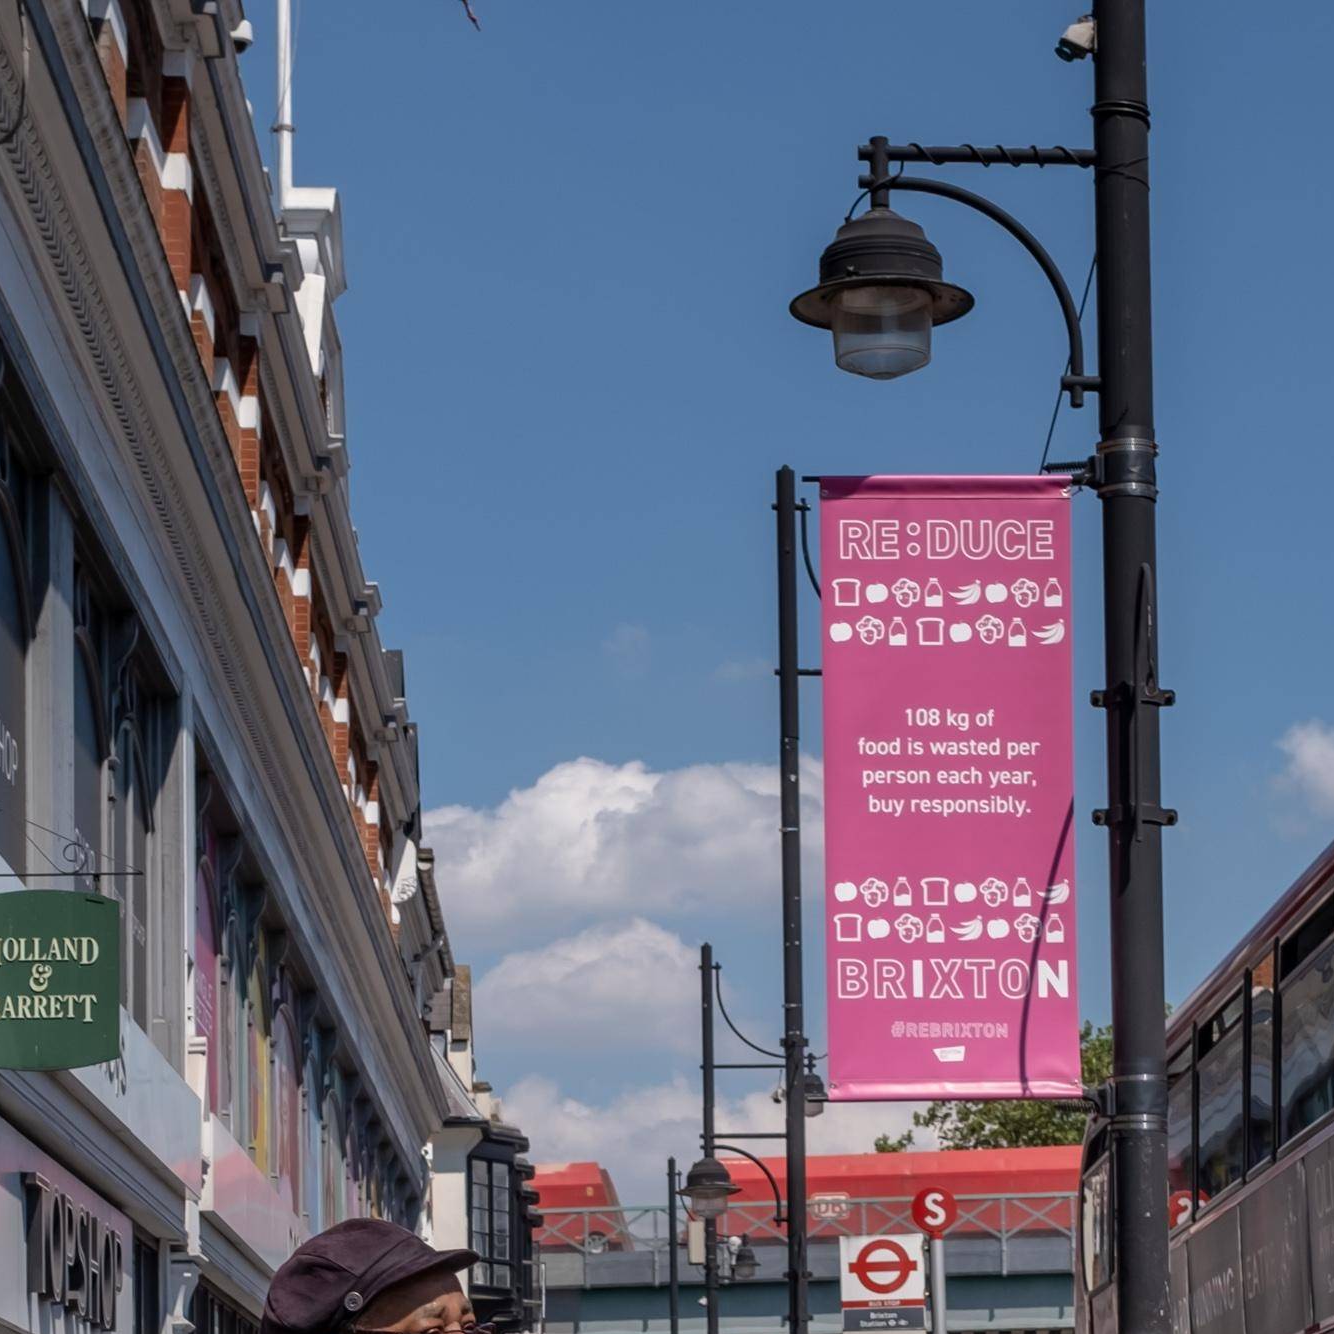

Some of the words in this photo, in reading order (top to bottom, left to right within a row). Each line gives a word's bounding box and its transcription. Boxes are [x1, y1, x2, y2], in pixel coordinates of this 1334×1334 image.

[839, 519, 1055, 561] RE:DUCE
[905, 708, 941, 727] 108
[946, 708, 970, 732] kg
[975, 708, 995, 727] of
[857, 737, 901, 756] food
[907, 737, 924, 756] is
[929, 738, 1001, 756] wasted
[1007, 741, 1041, 760] per
[862, 769, 931, 788] person
[936, 766, 983, 785] each
[988, 770, 1037, 789] year,
[868, 794, 905, 817] buy
[910, 795, 1032, 818] responsibly.
[29, 963, 53, 993] &
[837, 958, 1069, 999] BRIXTON
[890, 1021, 1009, 1039] #REBRIXTON
[924, 1192, 947, 1227] S
[25, 1172, 123, 1331] TOPSHOP
